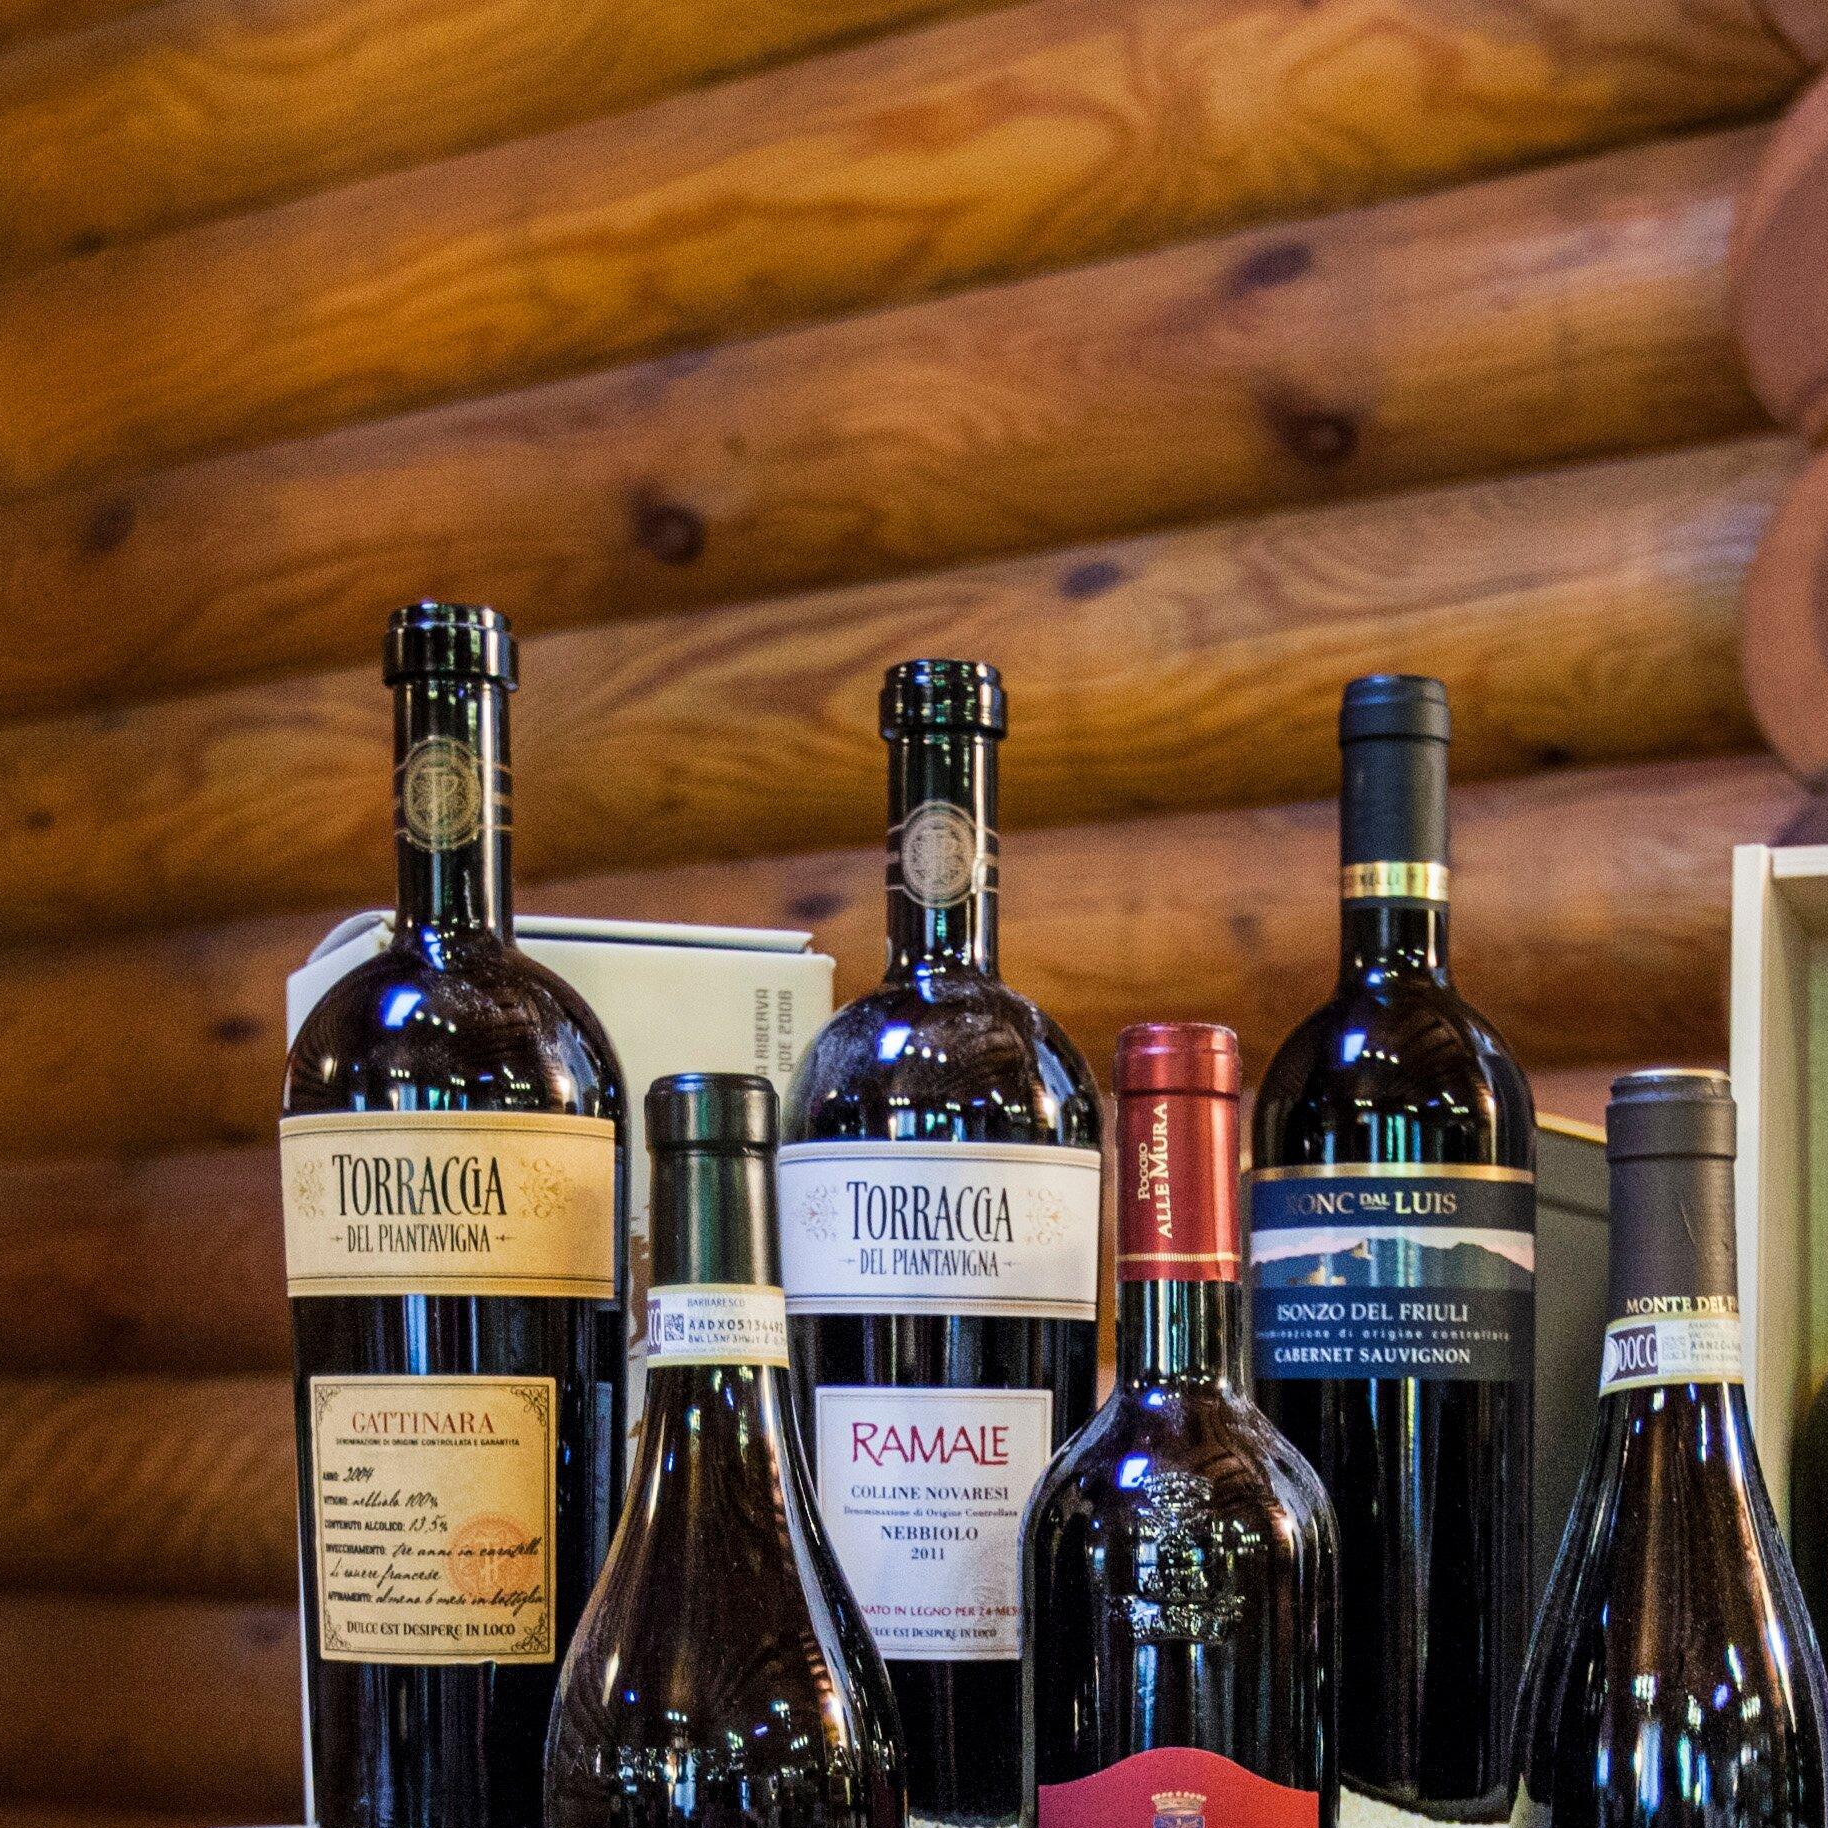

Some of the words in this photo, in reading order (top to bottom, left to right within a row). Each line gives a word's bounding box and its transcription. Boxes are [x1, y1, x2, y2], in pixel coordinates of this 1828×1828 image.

[1148, 1102, 1169, 1180] MURA
[1137, 1142, 1150, 1201] POGGIO
[1155, 1182, 1173, 1239] ALLE
[1359, 1193, 1390, 1206] DAL
[1394, 1191, 1457, 1215] LUIS
[348, 1224, 373, 1253] DEL
[379, 1224, 491, 1253] PIANTAVIGNA
[860, 1248, 887, 1275] DEL
[893, 1248, 999, 1277] PIANTAVIGNA
[1276, 1303, 1345, 1322] ISONZO
[1351, 1303, 1393, 1321] DEL
[1400, 1303, 1468, 1322] FRIULI
[1626, 1296, 1691, 1314] MONTE
[1274, 1347, 1353, 1363] CABERNET
[1360, 1347, 1471, 1365] SAUVIGNON
[352, 1411, 496, 1434] GATTINARA
[851, 1422, 1010, 1467] RAMALE
[851, 1485, 921, 1500] COLLINE
[925, 1486, 1009, 1501] NOVARESI
[844, 1506, 911, 1517] Denominazione
[913, 1506, 923, 1517] di
[926, 1507, 962, 1520] Origine
[965, 1507, 1018, 1518] Controllata
[880, 1525, 979, 1541] NEBBIOLO
[347, 1620, 378, 1635] DULCE
[380, 1621, 399, 1635] EST
[403, 1623, 463, 1640] DESIPERE
[467, 1623, 480, 1636] IN
[483, 1623, 515, 1636] LOCO
